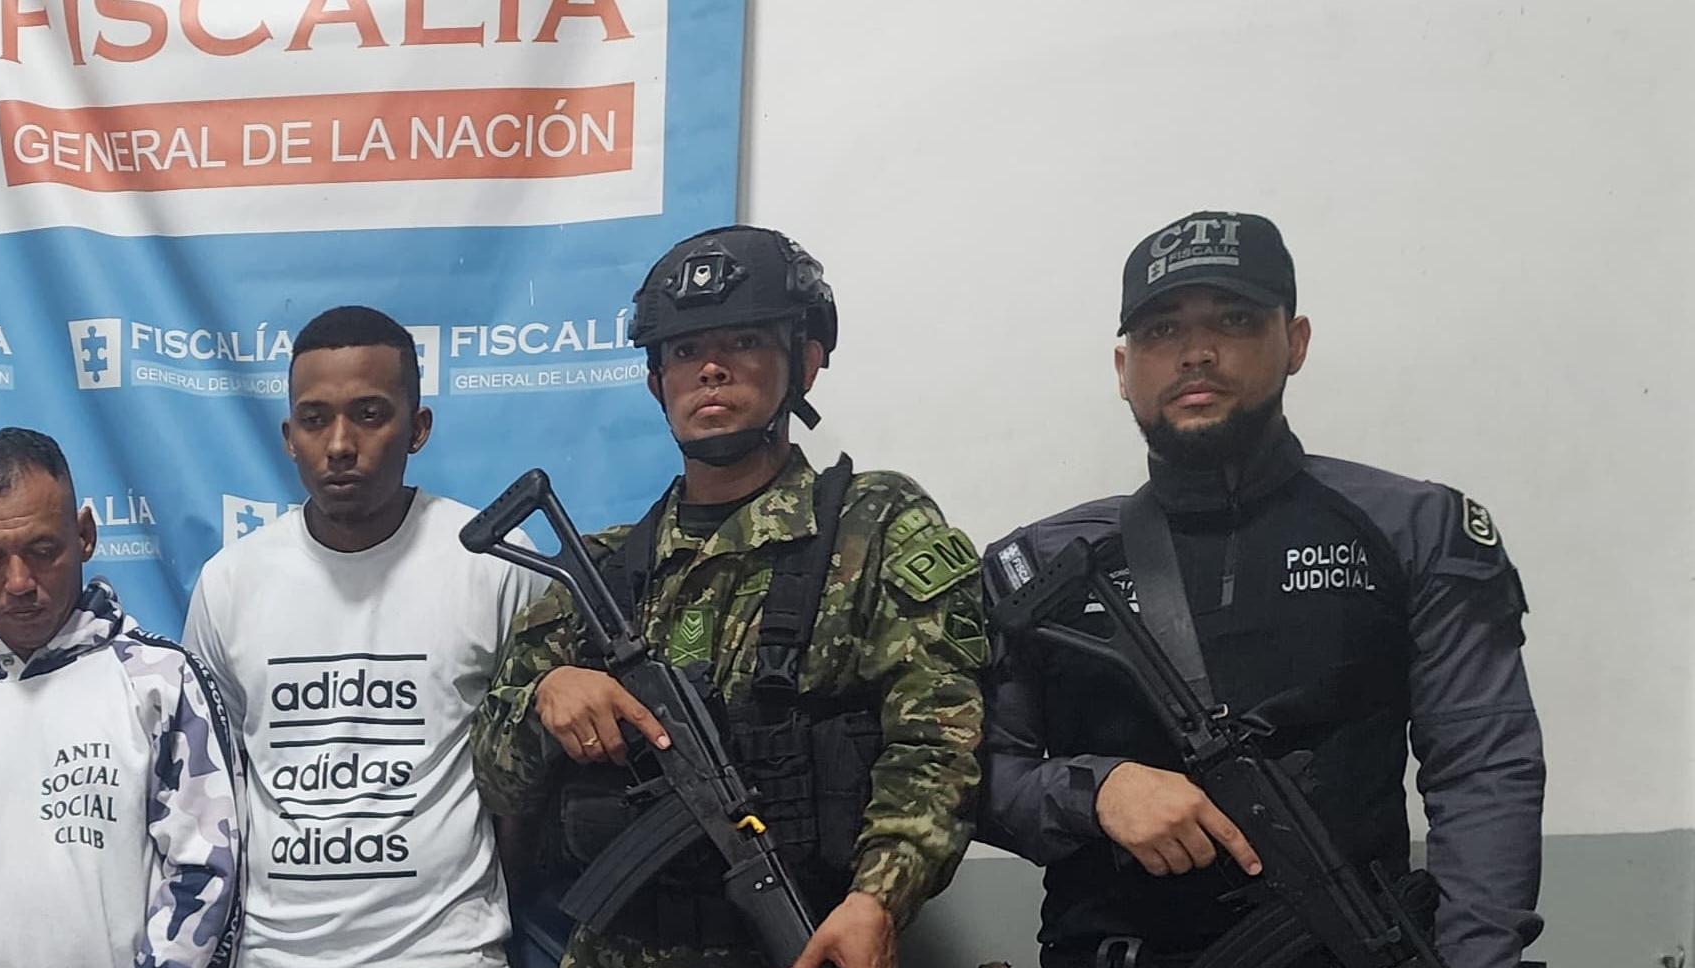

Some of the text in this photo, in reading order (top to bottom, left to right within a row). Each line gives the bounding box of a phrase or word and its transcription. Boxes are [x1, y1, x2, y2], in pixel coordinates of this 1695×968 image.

[13, 99, 616, 173] GENERAL DE LA NACIÓN
[1150, 219, 1241, 258] CTI
[131, 322, 294, 362] FISCALÍA
[450, 308, 635, 357] FISCALÍ
[136, 366, 205, 391] GENERAL
[209, 377, 229, 391] DE
[455, 373, 533, 389] GENERAL
[539, 371, 561, 386] DE
[567, 369, 586, 385] LA
[905, 534, 974, 586] PM
[1286, 539, 1369, 570] POLICÍA
[1281, 568, 1376, 593] JUDICIAL
[271, 670, 418, 711] adidas
[54, 742, 111, 768] ANTI
[272, 752, 414, 792] adidas
[41, 767, 120, 796] SOCIAL
[40, 794, 118, 824] SOCIAL
[54, 826, 105, 850] CLUB
[271, 827, 409, 865] adidas
